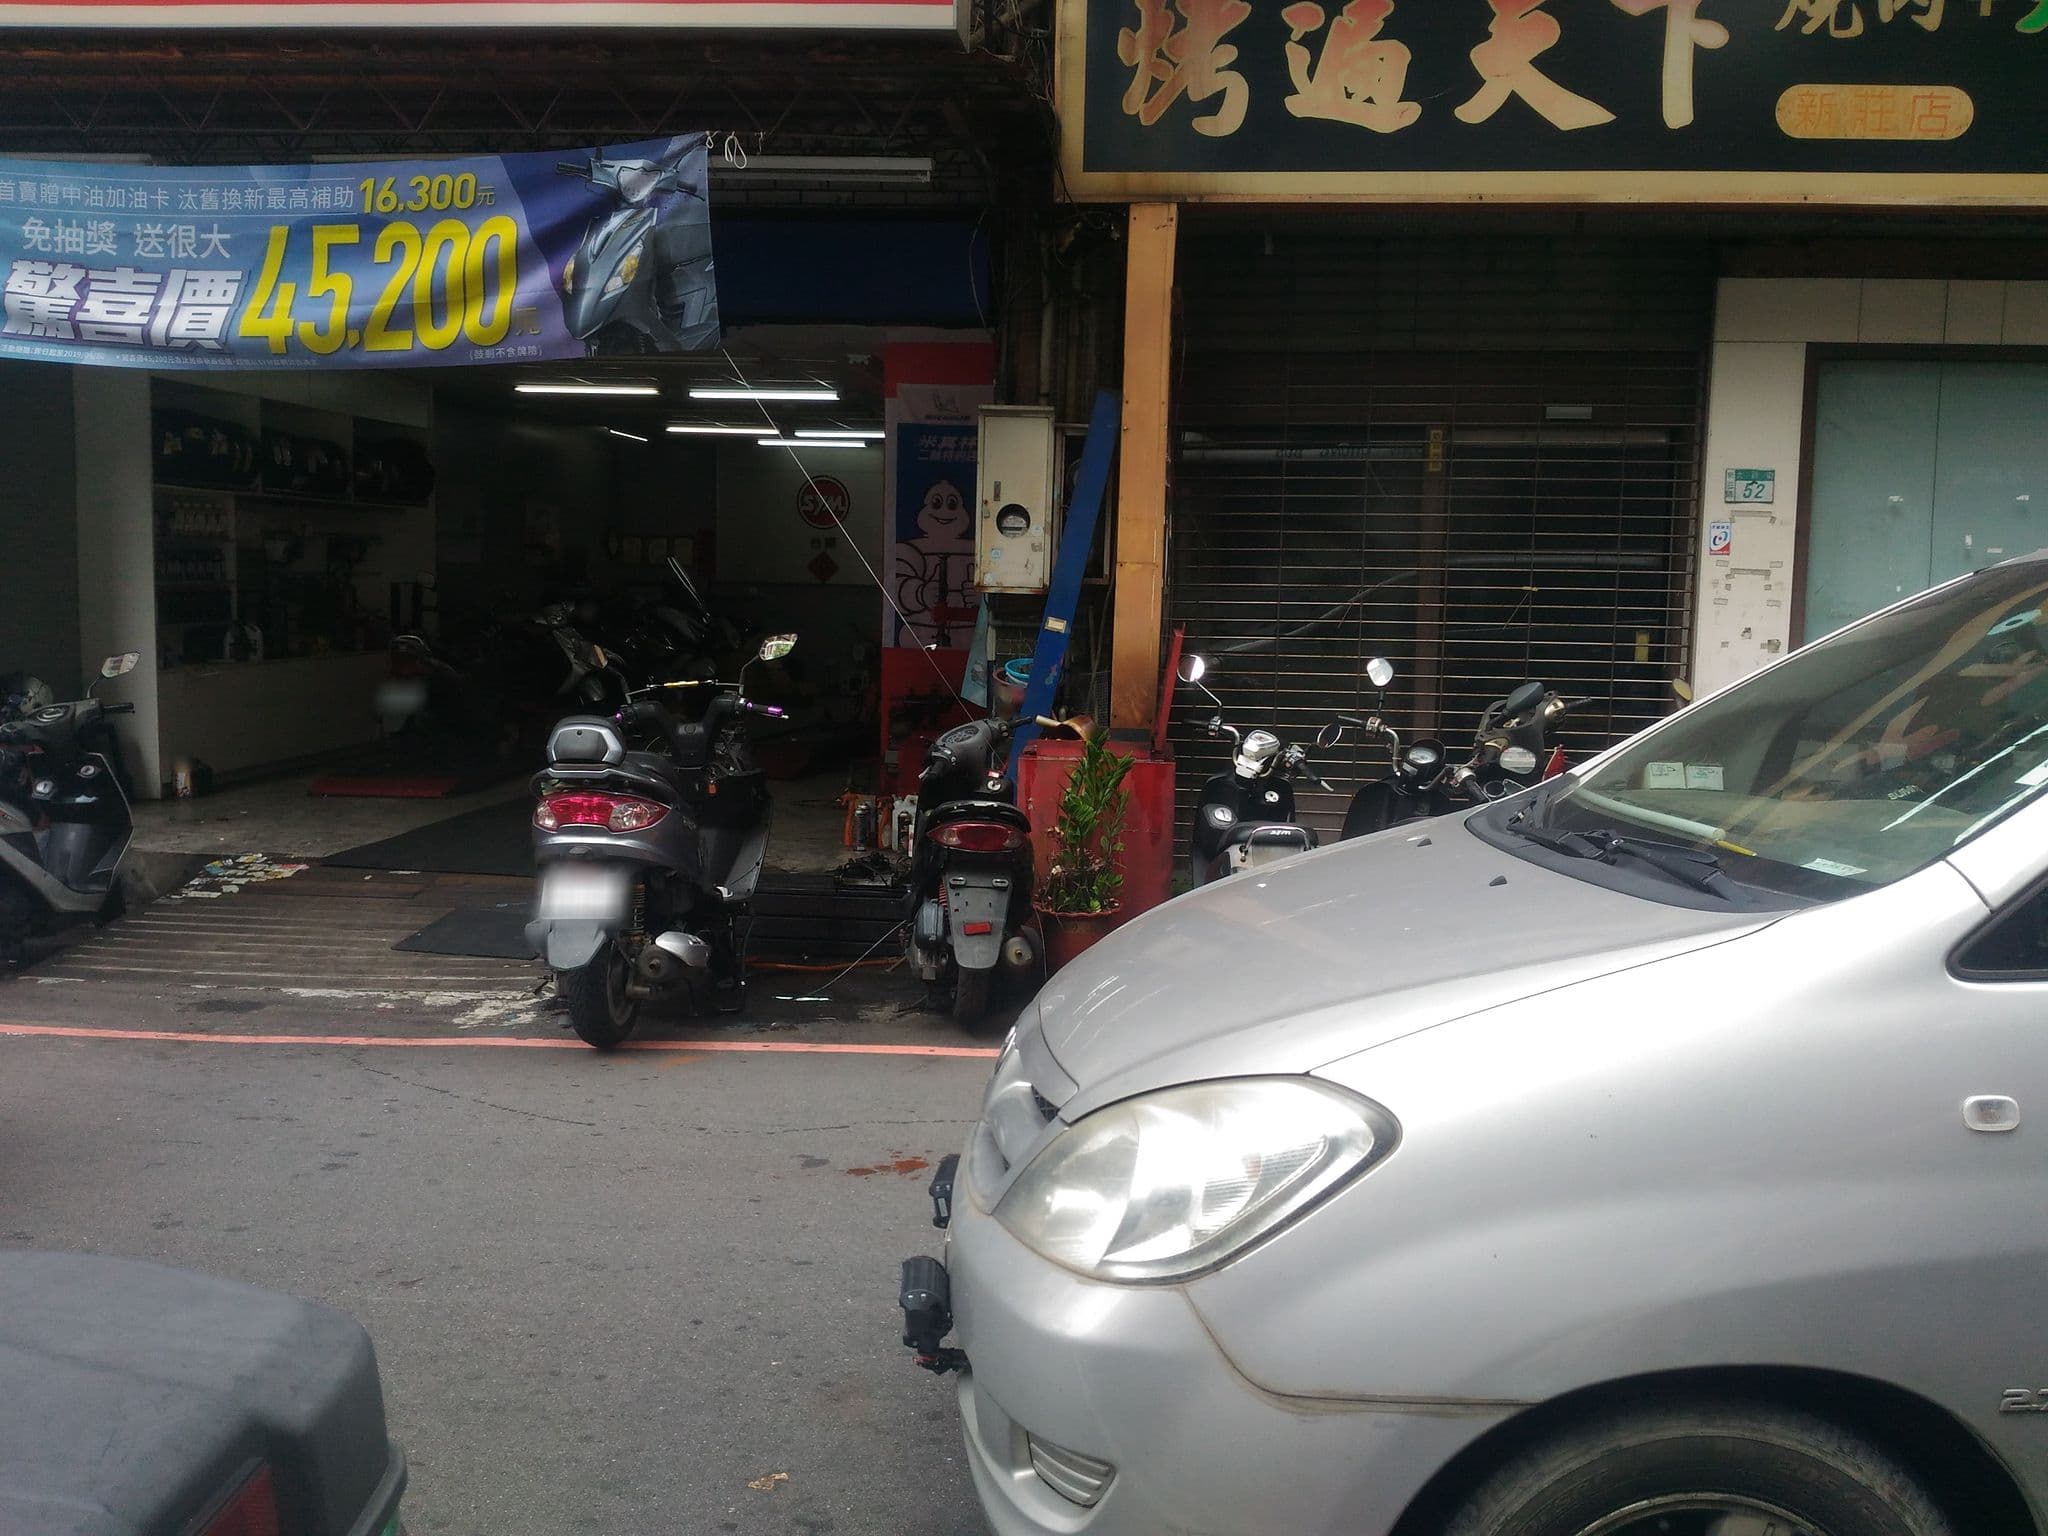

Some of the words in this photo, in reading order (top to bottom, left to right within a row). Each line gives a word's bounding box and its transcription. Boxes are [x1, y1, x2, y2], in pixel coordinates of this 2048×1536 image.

[1793, 90, 1953, 134] 新莊店
[22, 217, 118, 256] 免抽獎
[133, 223, 232, 259] 送很大
[1743, 481, 1766, 499] 52
